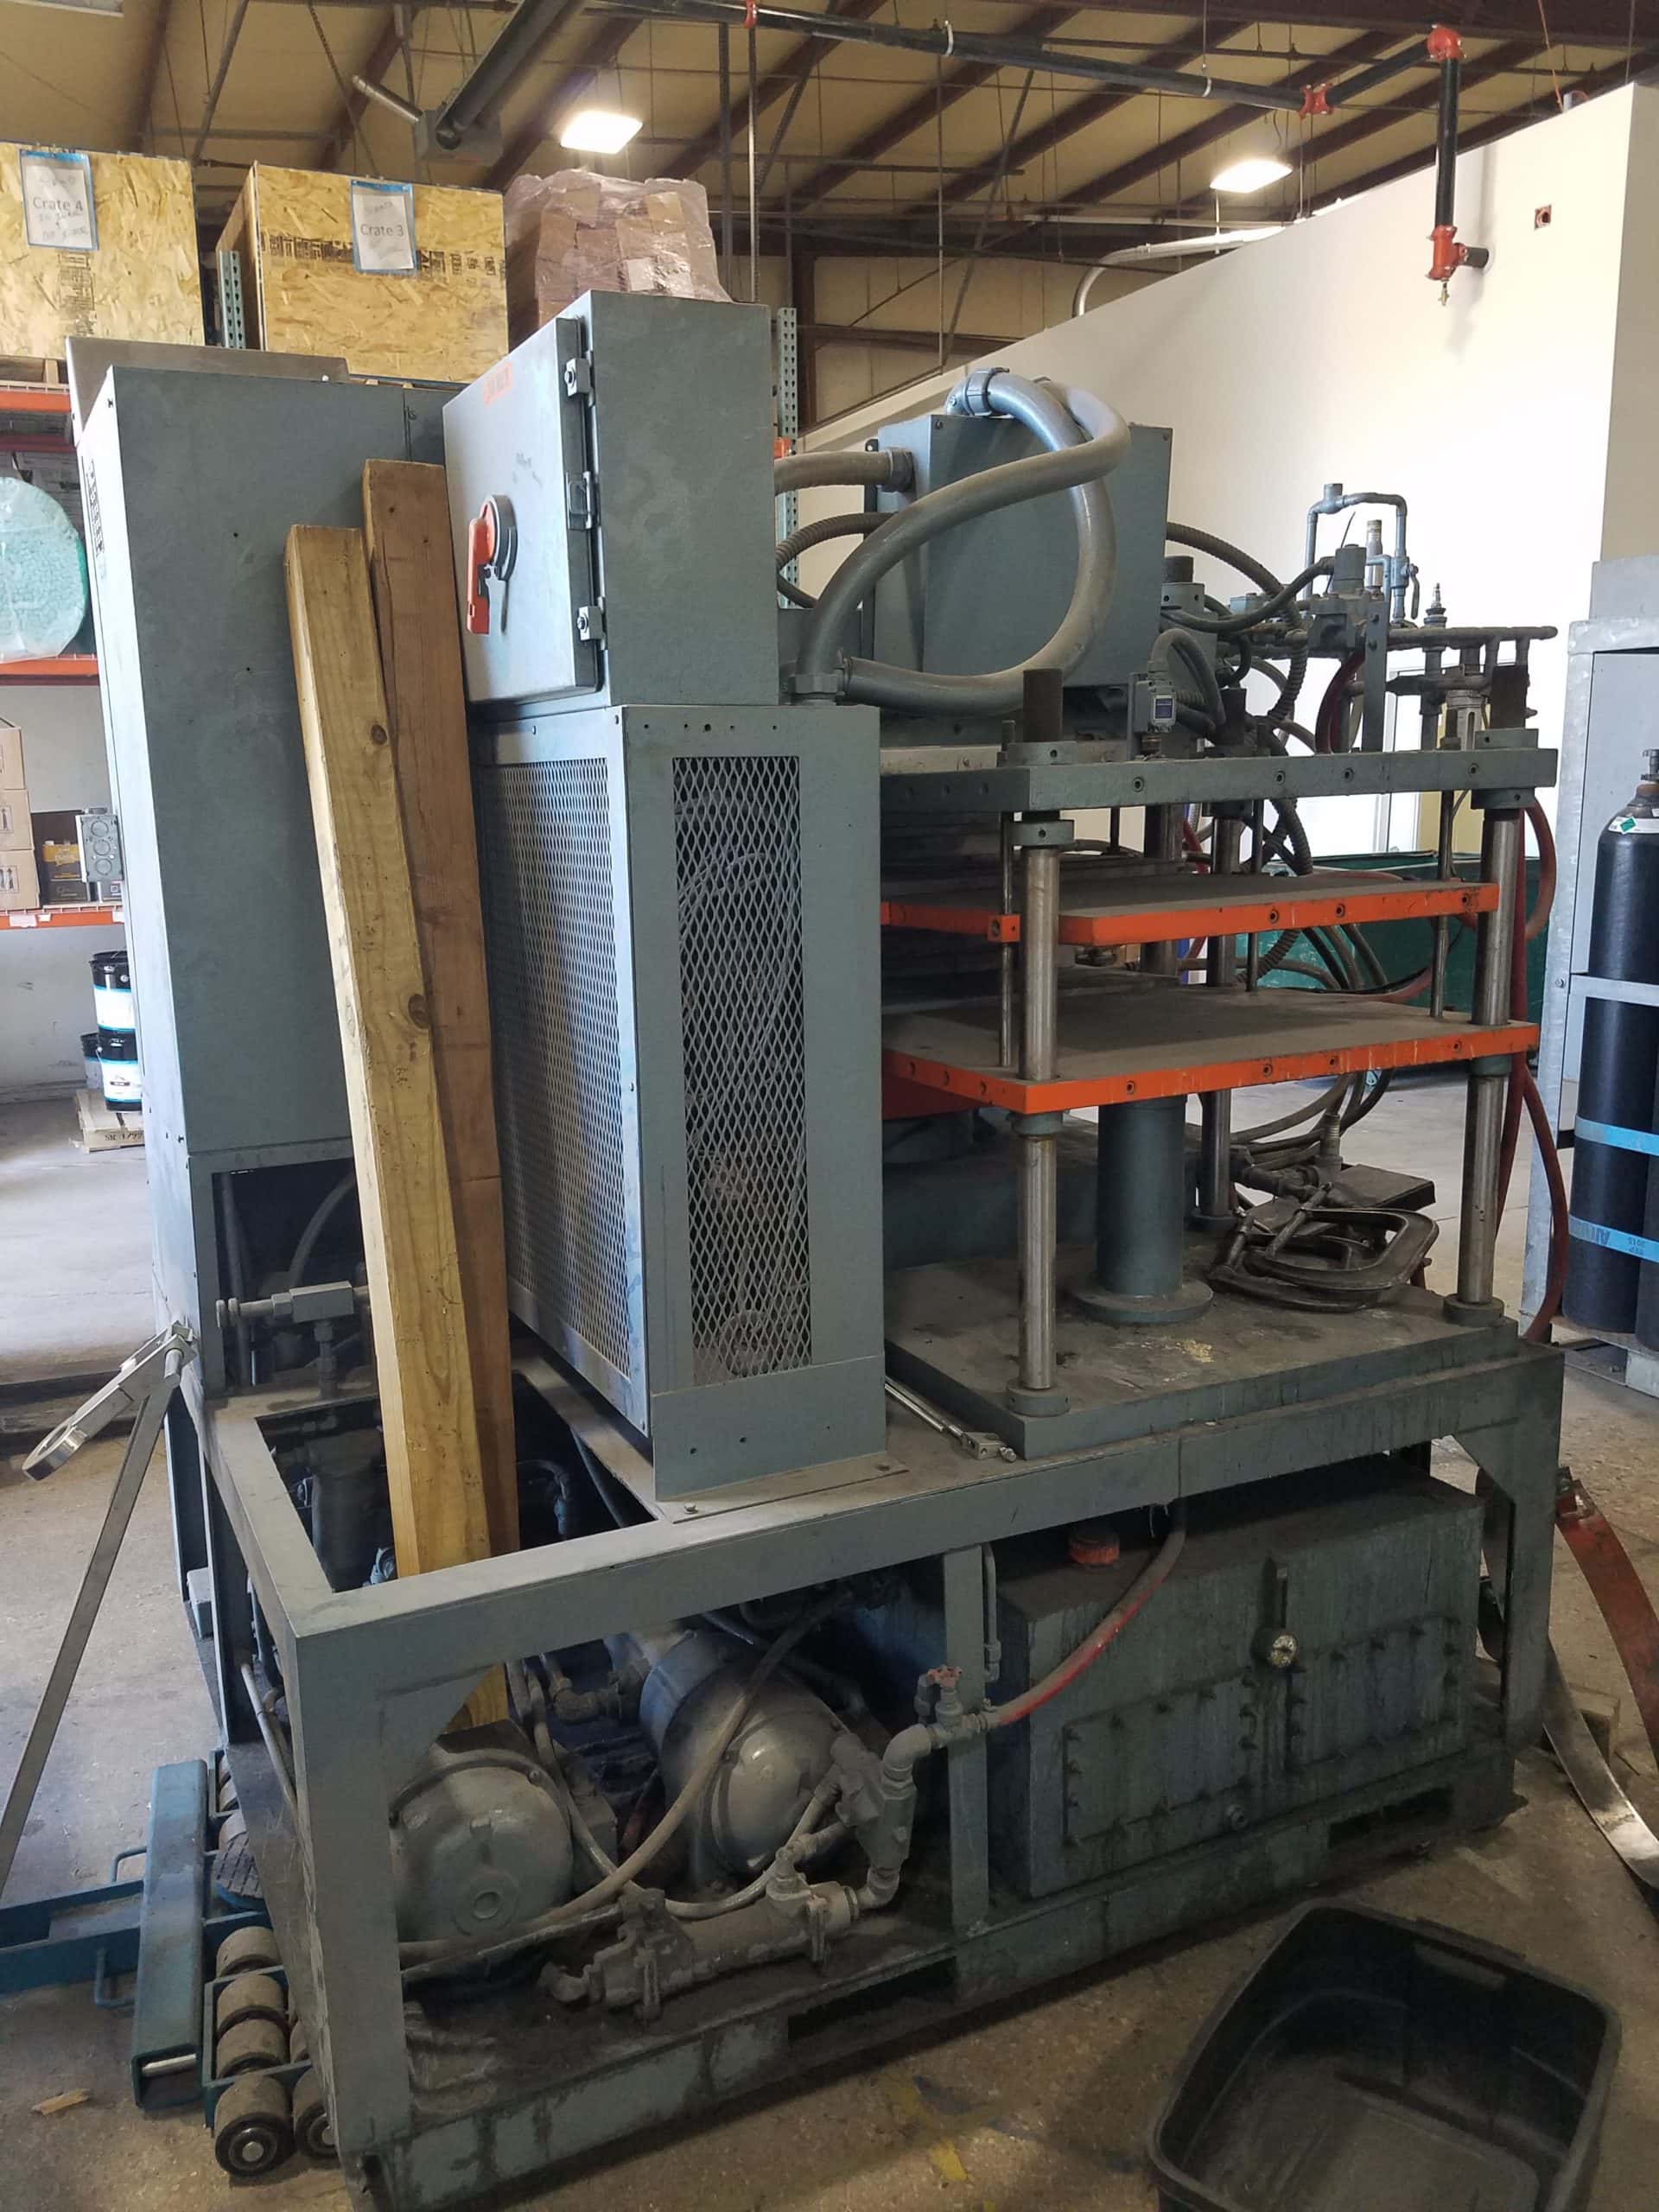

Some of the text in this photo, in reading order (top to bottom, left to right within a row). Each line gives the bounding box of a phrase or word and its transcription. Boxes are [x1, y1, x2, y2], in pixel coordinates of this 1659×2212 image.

[33, 197, 84, 212] Crate 4
[359, 223, 404, 237] Crate 3
